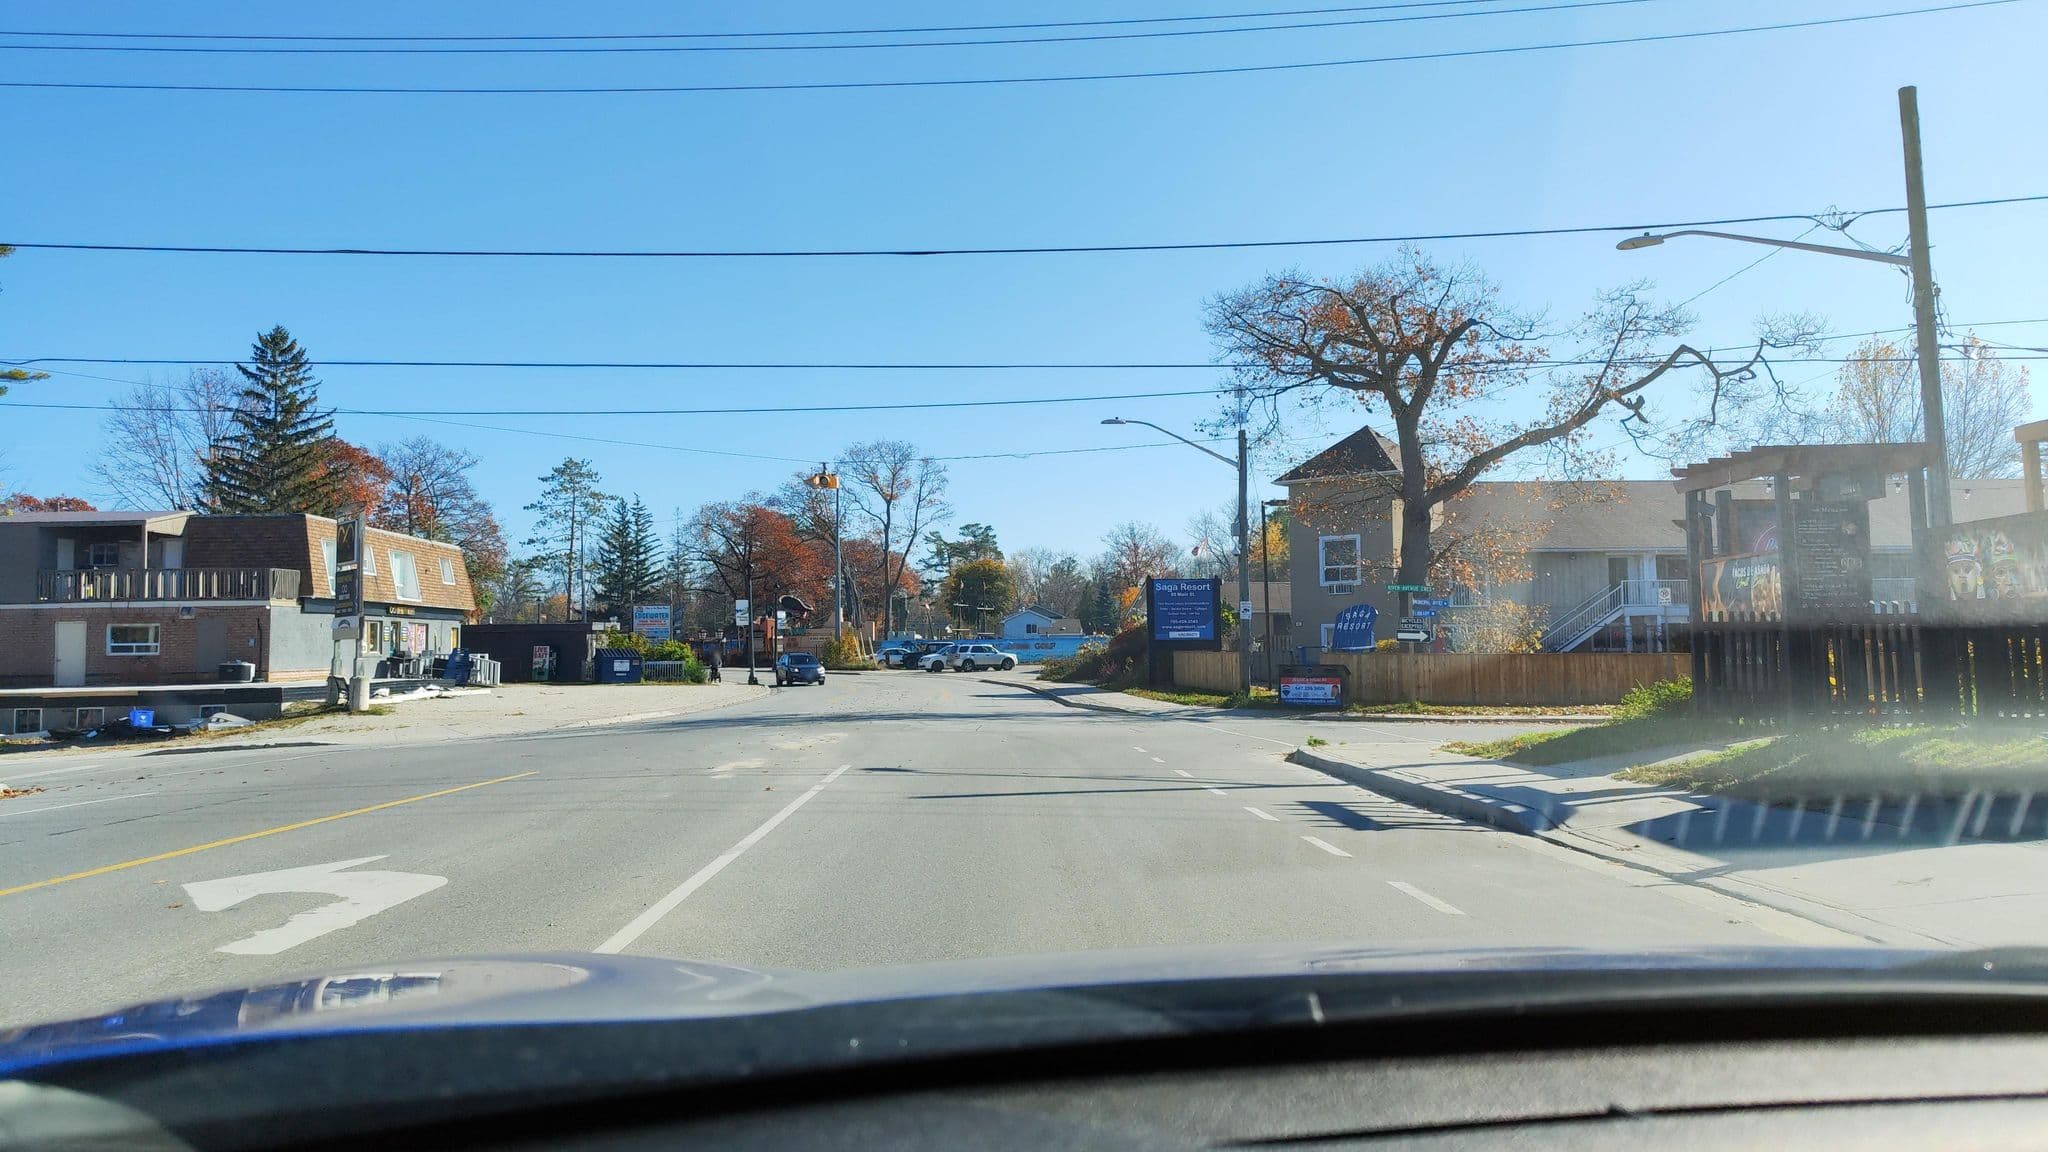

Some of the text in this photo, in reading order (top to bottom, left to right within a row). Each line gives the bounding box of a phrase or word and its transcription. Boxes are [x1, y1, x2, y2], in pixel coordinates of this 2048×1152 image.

[1155, 582, 1212, 593] Saga Resort
[1345, 609, 1371, 620] SAGA
[1336, 621, 1371, 631] RESORT
